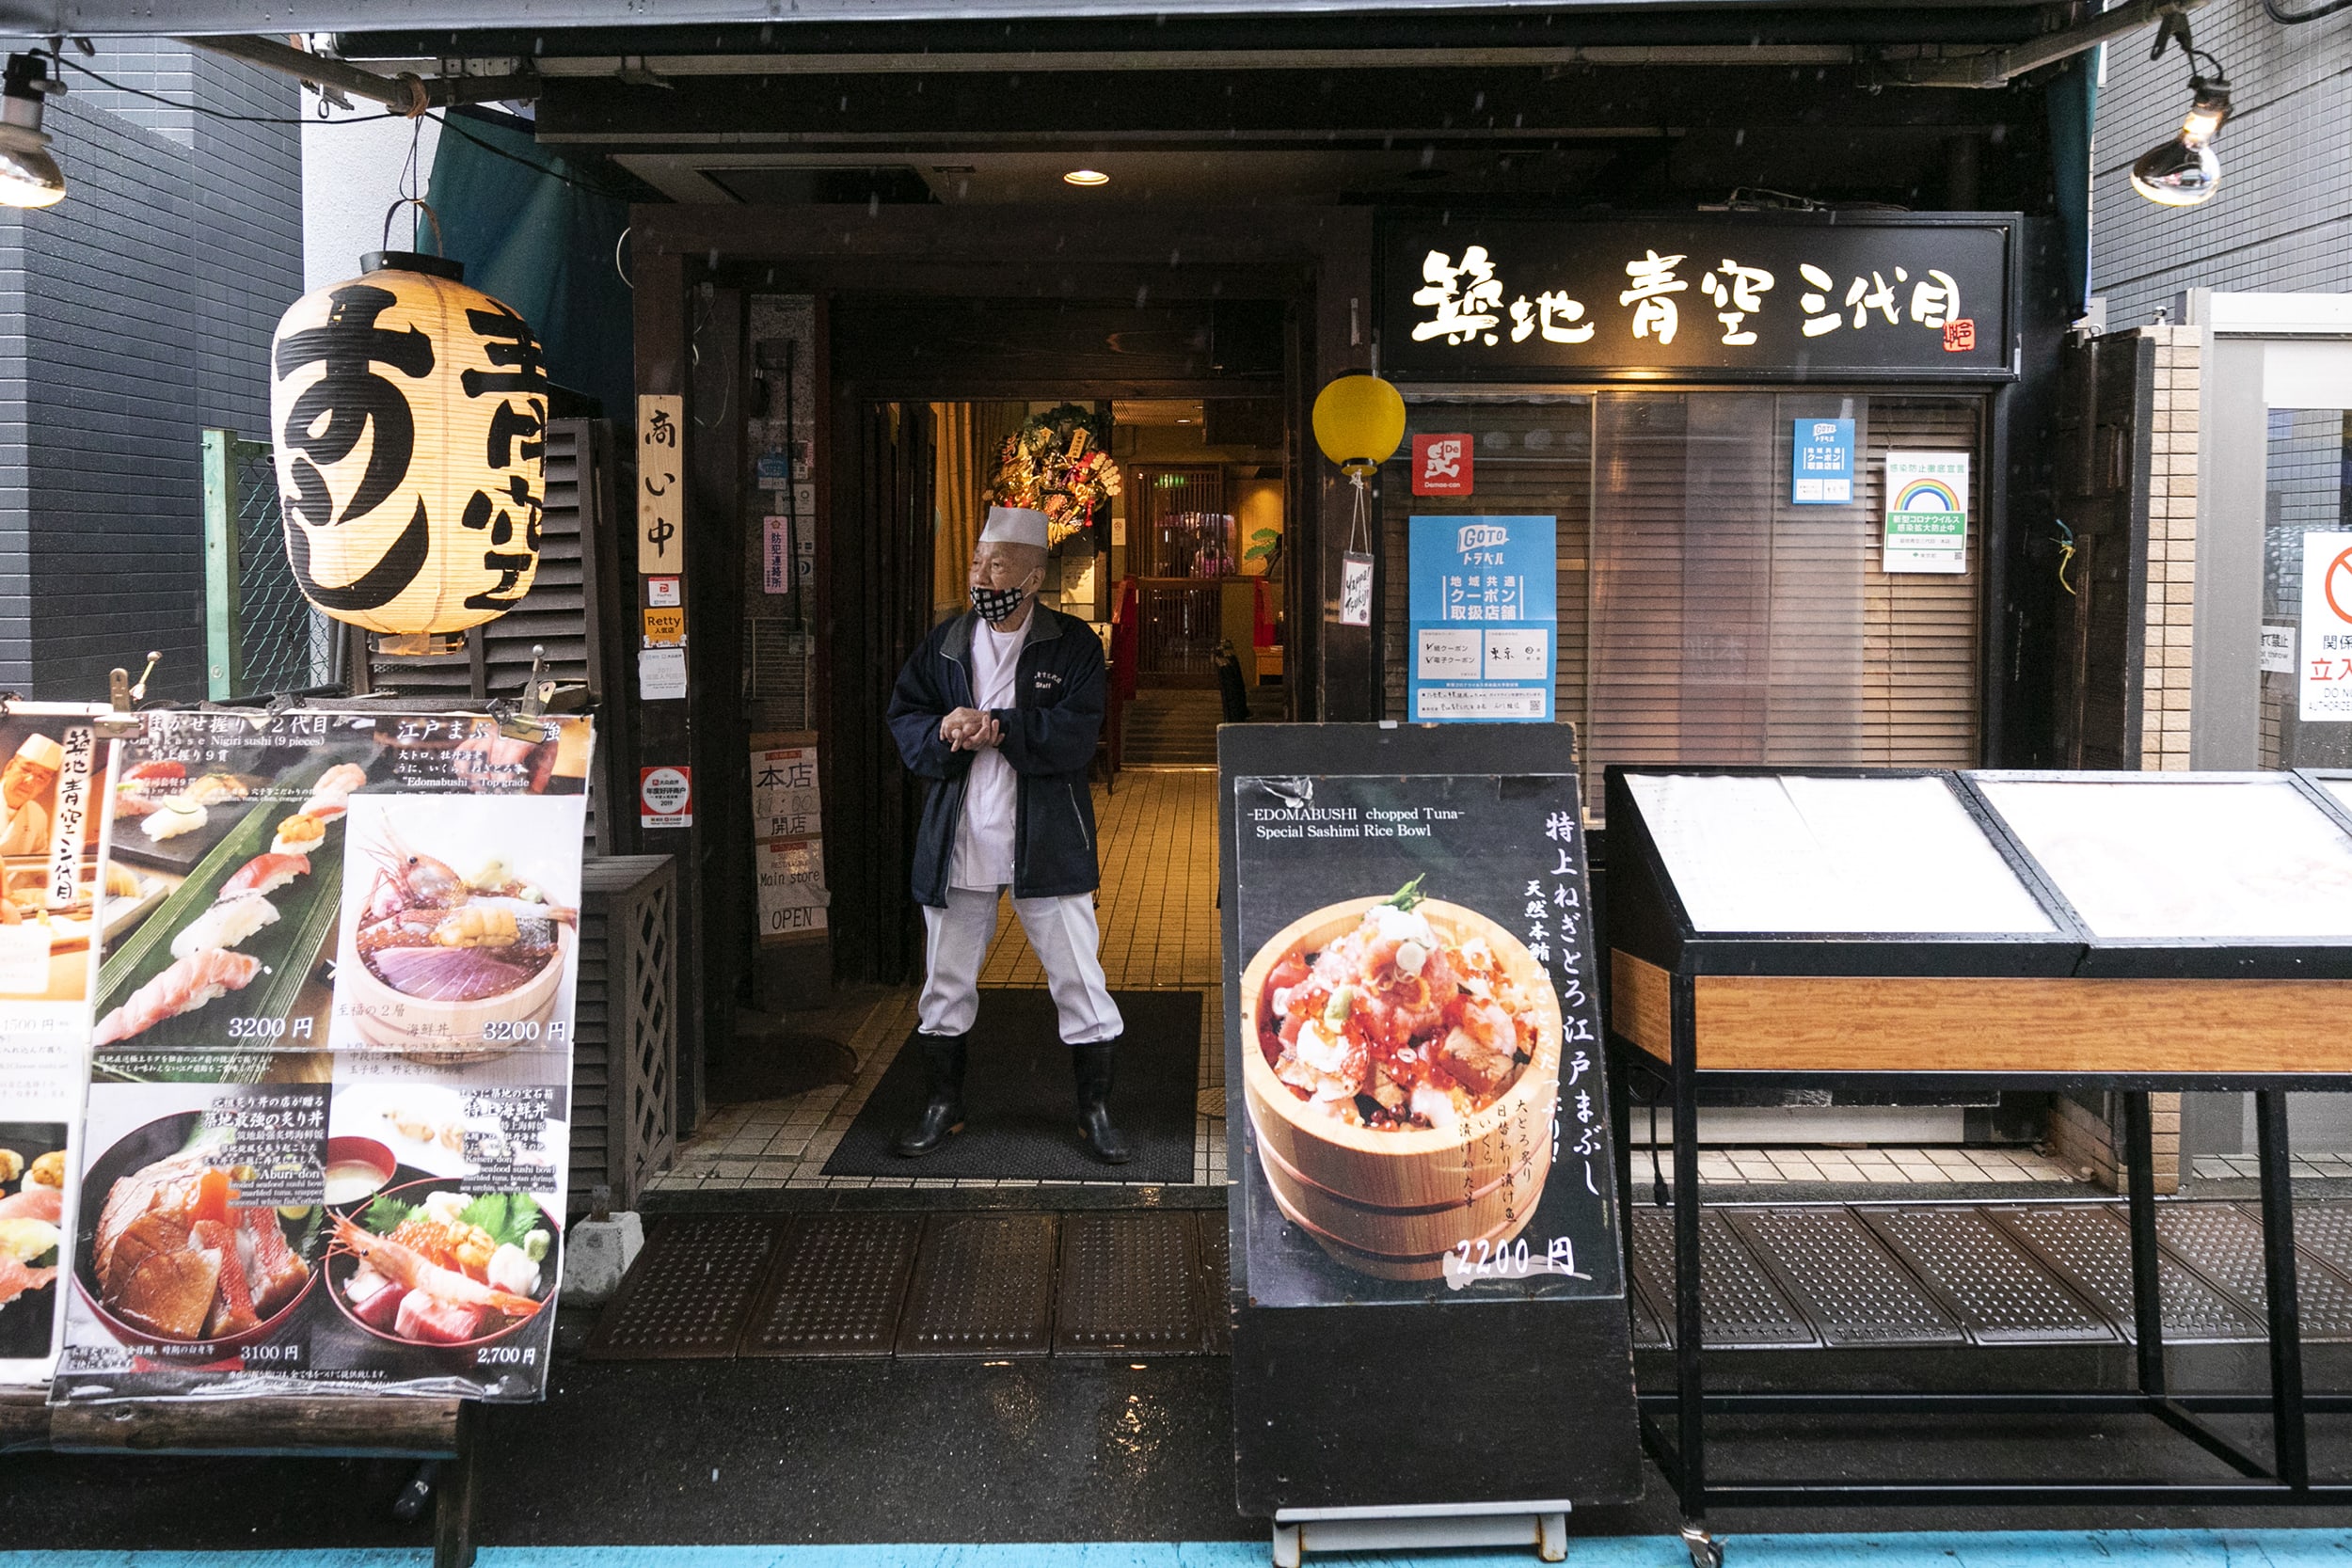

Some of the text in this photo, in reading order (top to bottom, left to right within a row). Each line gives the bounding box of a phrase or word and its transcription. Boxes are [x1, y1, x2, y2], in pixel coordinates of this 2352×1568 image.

[1412, 245, 1962, 345] 築地 青空 三代目
[1445, 445, 1459, 453] De
[1889, 464, 1964, 473] 感染防止徹底宣言
[644, 409, 676, 559] 商い中
[1893, 515, 1960, 524] 新型コロナウイルス
[1898, 523, 1956, 532] 感染拡大防止中
[1464, 529, 1503, 547] GOTO
[1463, 553, 1504, 565] トラベル
[1450, 576, 1516, 587] 地域共通
[1450, 589, 1517, 603] クーポン
[1450, 605, 1517, 620] 取扱店舗
[647, 616, 681, 627] Retty
[210, 736, 242, 747] Nigiri
[244, 736, 272, 746] sushi
[755, 761, 814, 791] 本店
[1365, 808, 1419, 821] chopped
[771, 814, 807, 836] 開店
[1256, 824, 1432, 840] Special Sashimi Rice Bowl
[759, 867, 820, 888] Main store
[771, 906, 813, 930] OPEN
[227, 1016, 313, 1039] 3200 円
[482, 1020, 566, 1042] 3200 円
[1479, 1118, 1493, 1164] いくら
[1457, 1236, 1575, 1276] 2200 円
[241, 1344, 299, 1362] 3100 円
[477, 1348, 536, 1365] 2,700 円
